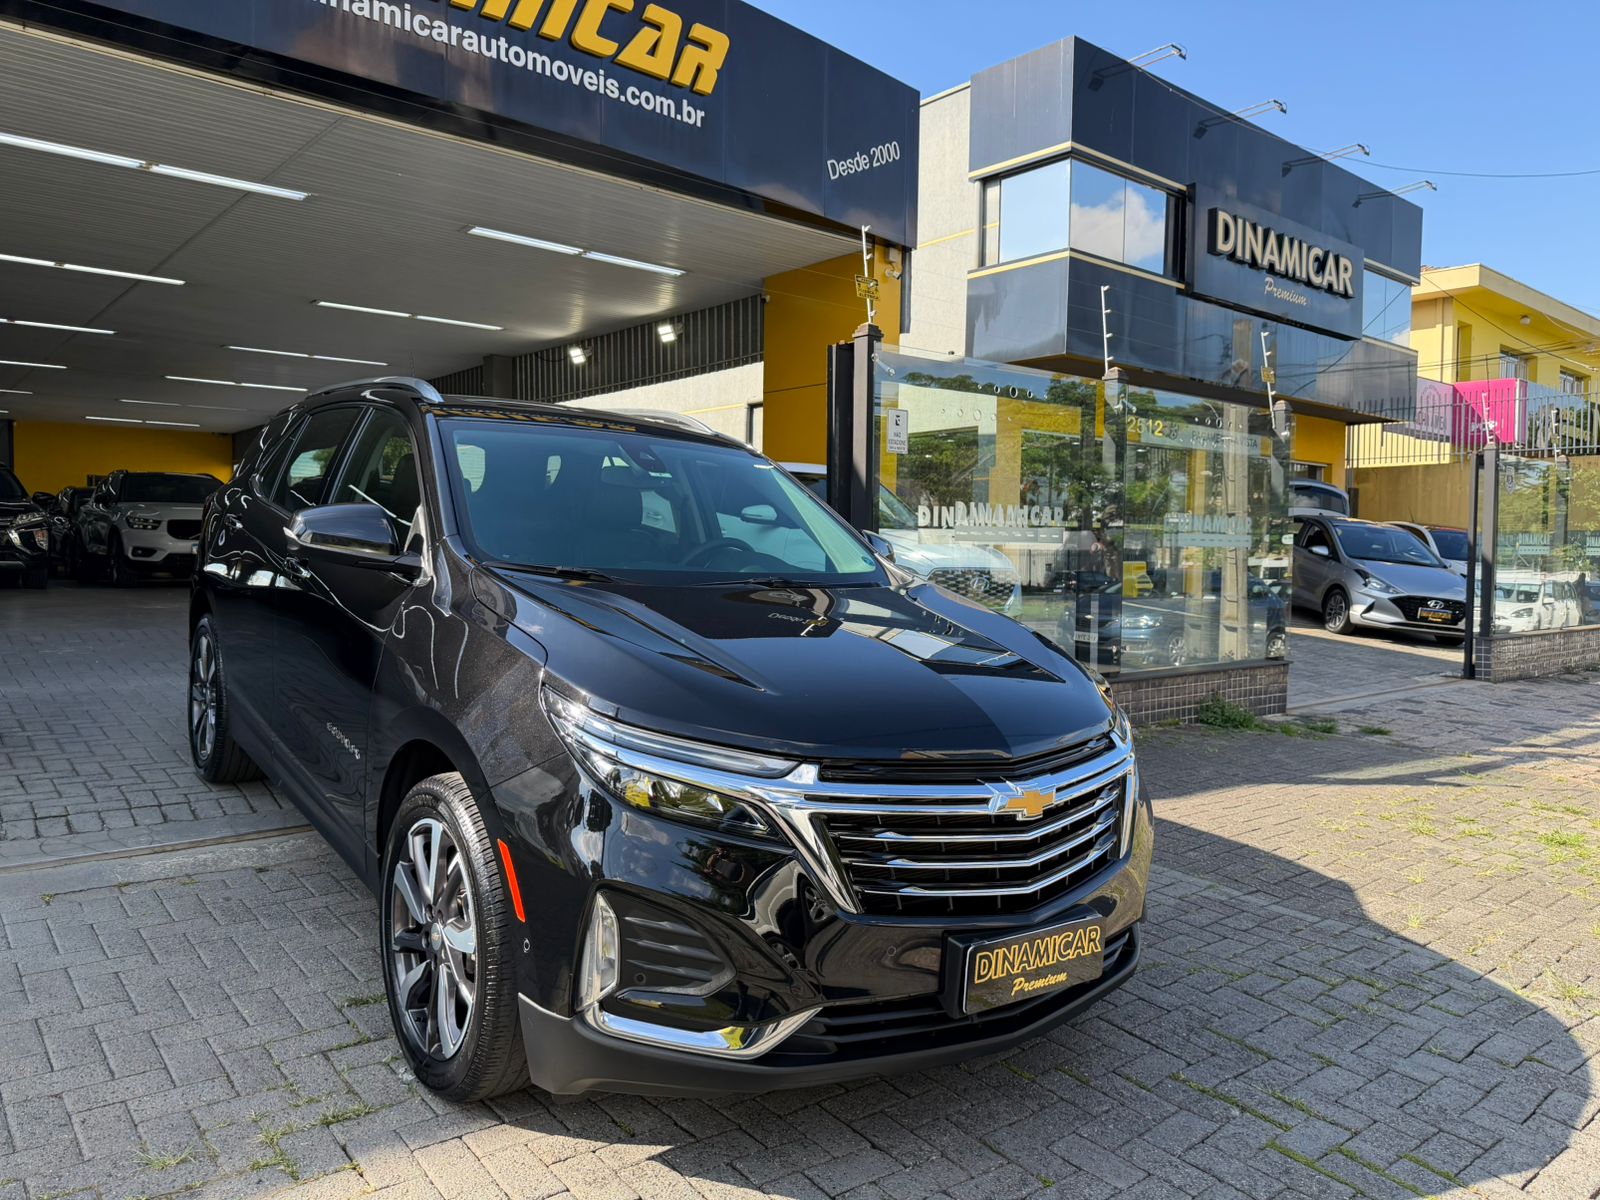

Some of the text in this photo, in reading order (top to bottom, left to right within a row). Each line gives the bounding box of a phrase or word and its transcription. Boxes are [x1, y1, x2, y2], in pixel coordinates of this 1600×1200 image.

[826, 141, 900, 180] Desde 2000
[1216, 210, 1355, 297] DINAMICAR
[1264, 276, 1308, 306] Premium
[975, 925, 1101, 984] DINAMICAR
[1011, 971, 1068, 998] Premium
